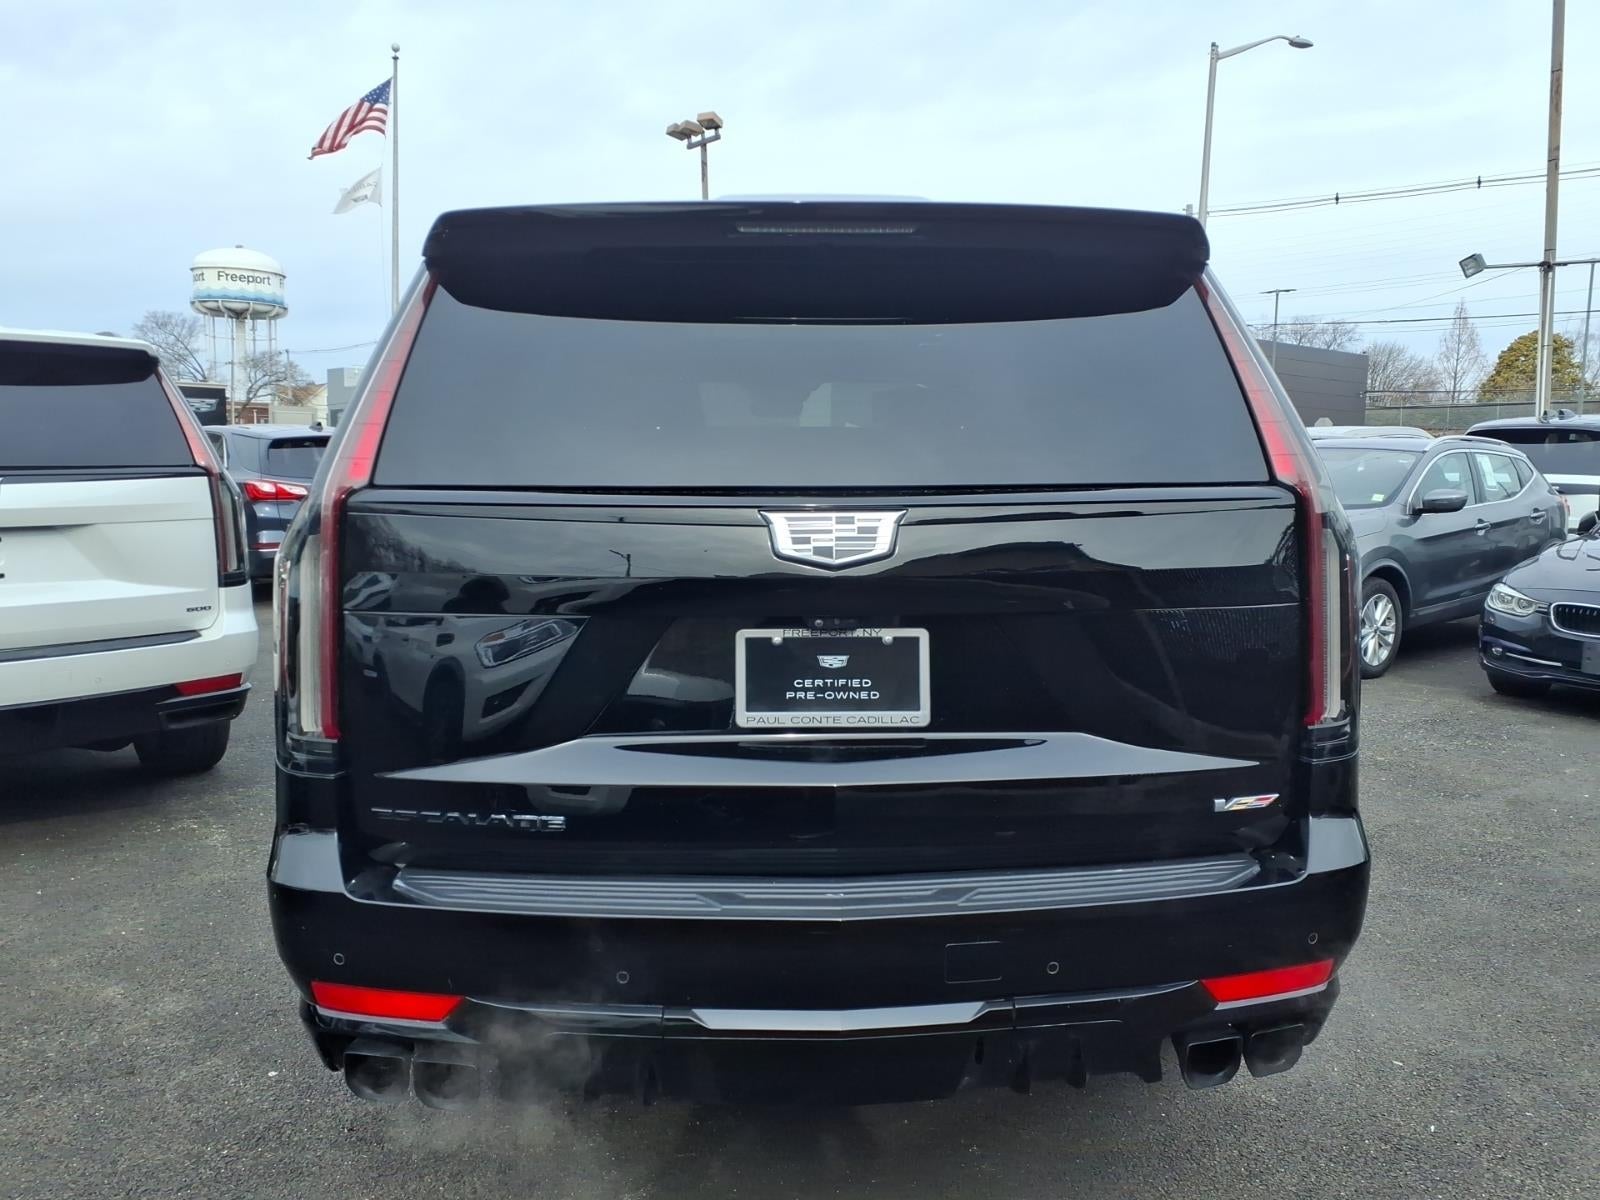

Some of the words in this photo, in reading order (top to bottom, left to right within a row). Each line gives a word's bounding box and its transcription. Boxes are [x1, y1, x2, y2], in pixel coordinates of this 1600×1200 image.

[217, 270, 271, 286] Freeport
[793, 679, 872, 688] CERTIFIED
[785, 691, 880, 700] PRE-OWNED
[745, 716, 786, 725] PAUL
[790, 716, 842, 725] CONTE
[846, 715, 920, 725] CADILLAC
